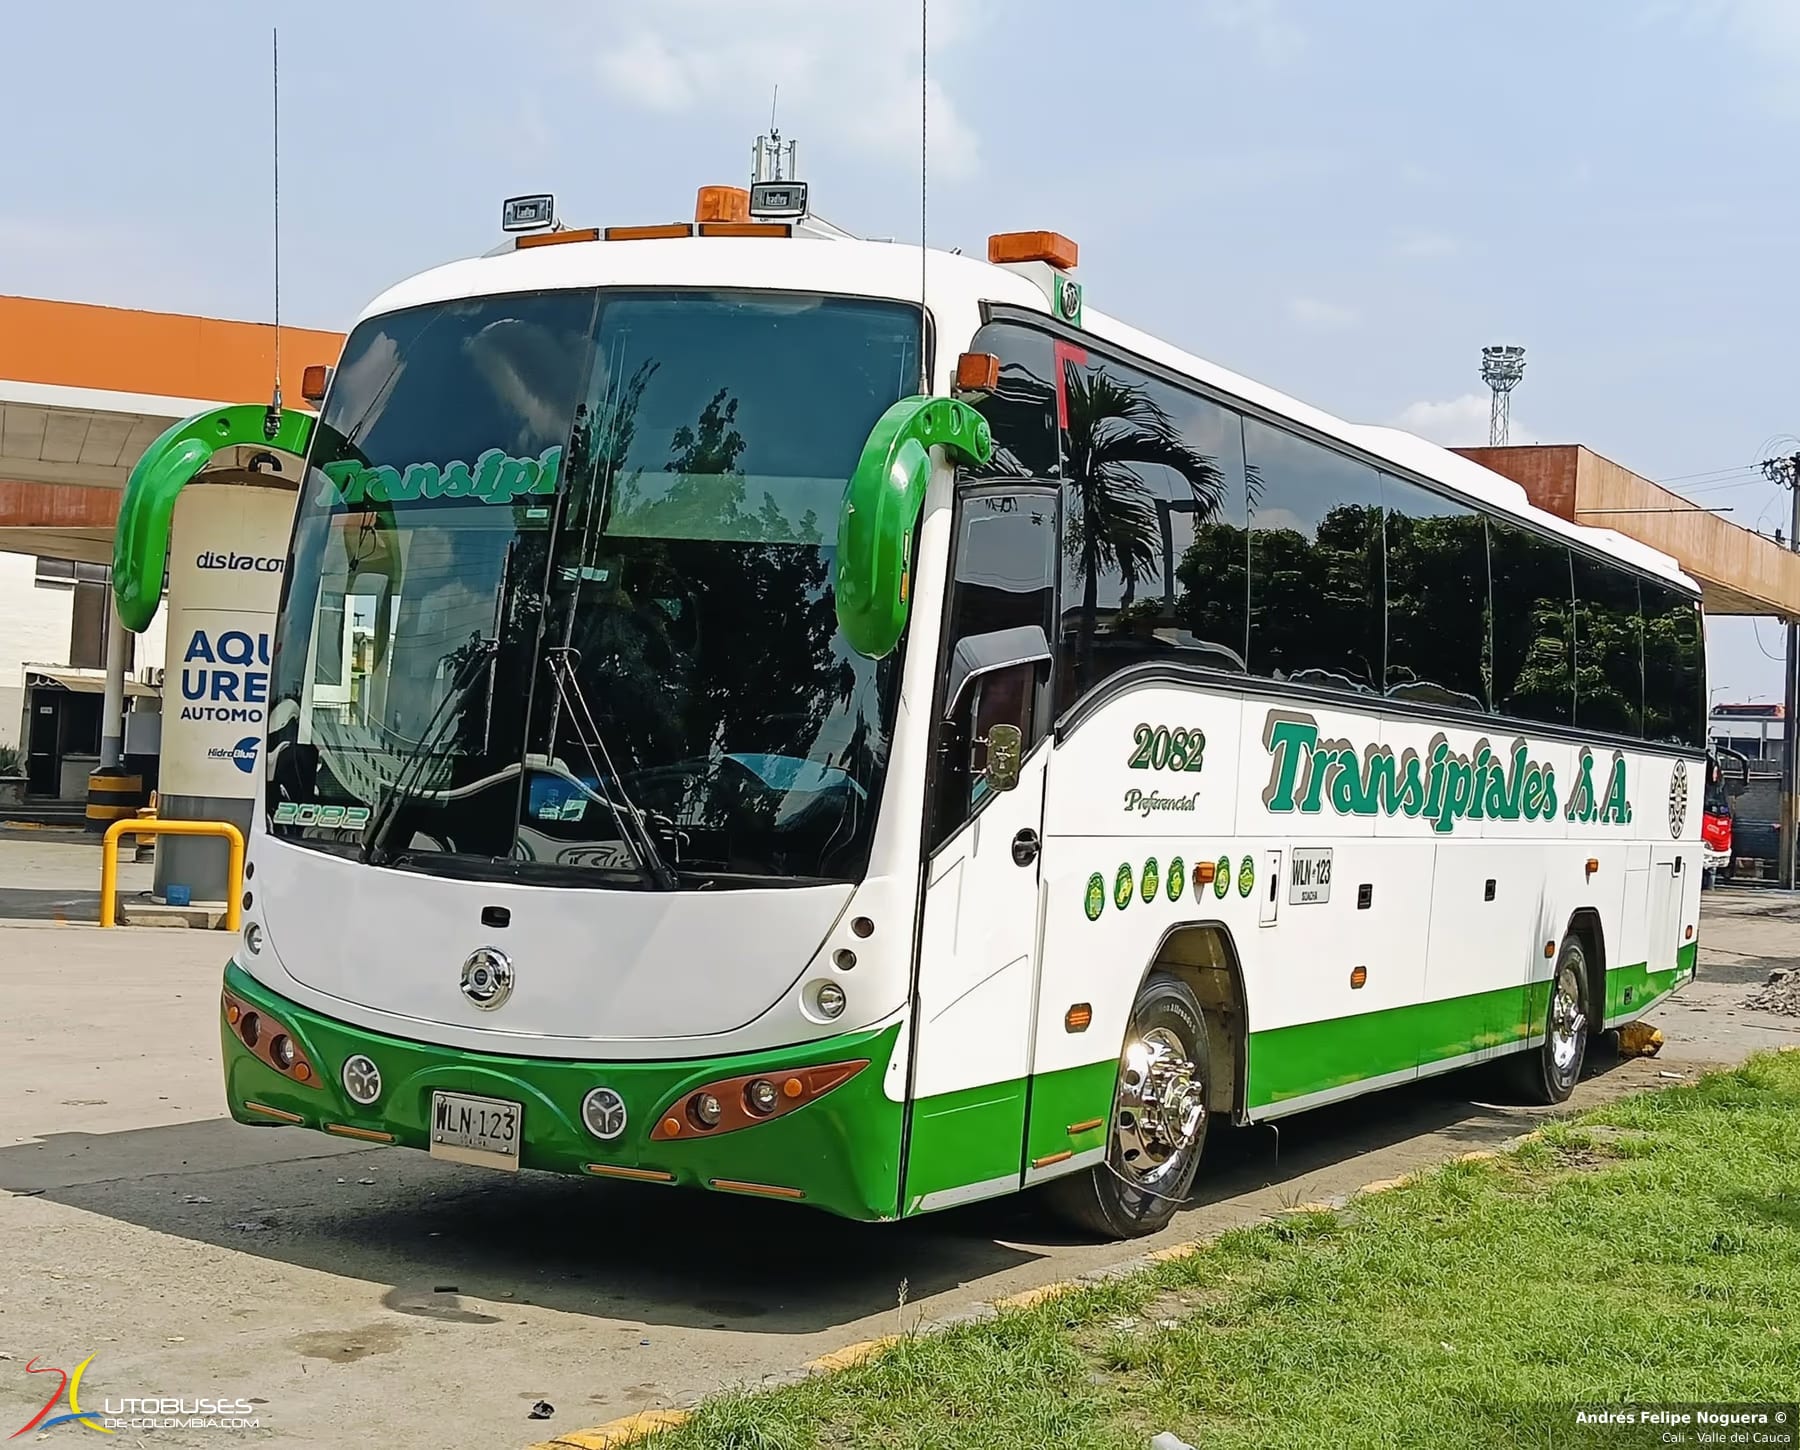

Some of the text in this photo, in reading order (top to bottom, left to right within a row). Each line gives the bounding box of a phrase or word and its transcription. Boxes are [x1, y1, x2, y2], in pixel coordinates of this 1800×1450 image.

[196, 551, 284, 573] distraco
[182, 669, 268, 702] URE
[180, 707, 263, 722] AUTOMO
[1127, 722, 1206, 772] 2082
[1262, 708, 1559, 834] Transipiales
[273, 802, 370, 830] 2082
